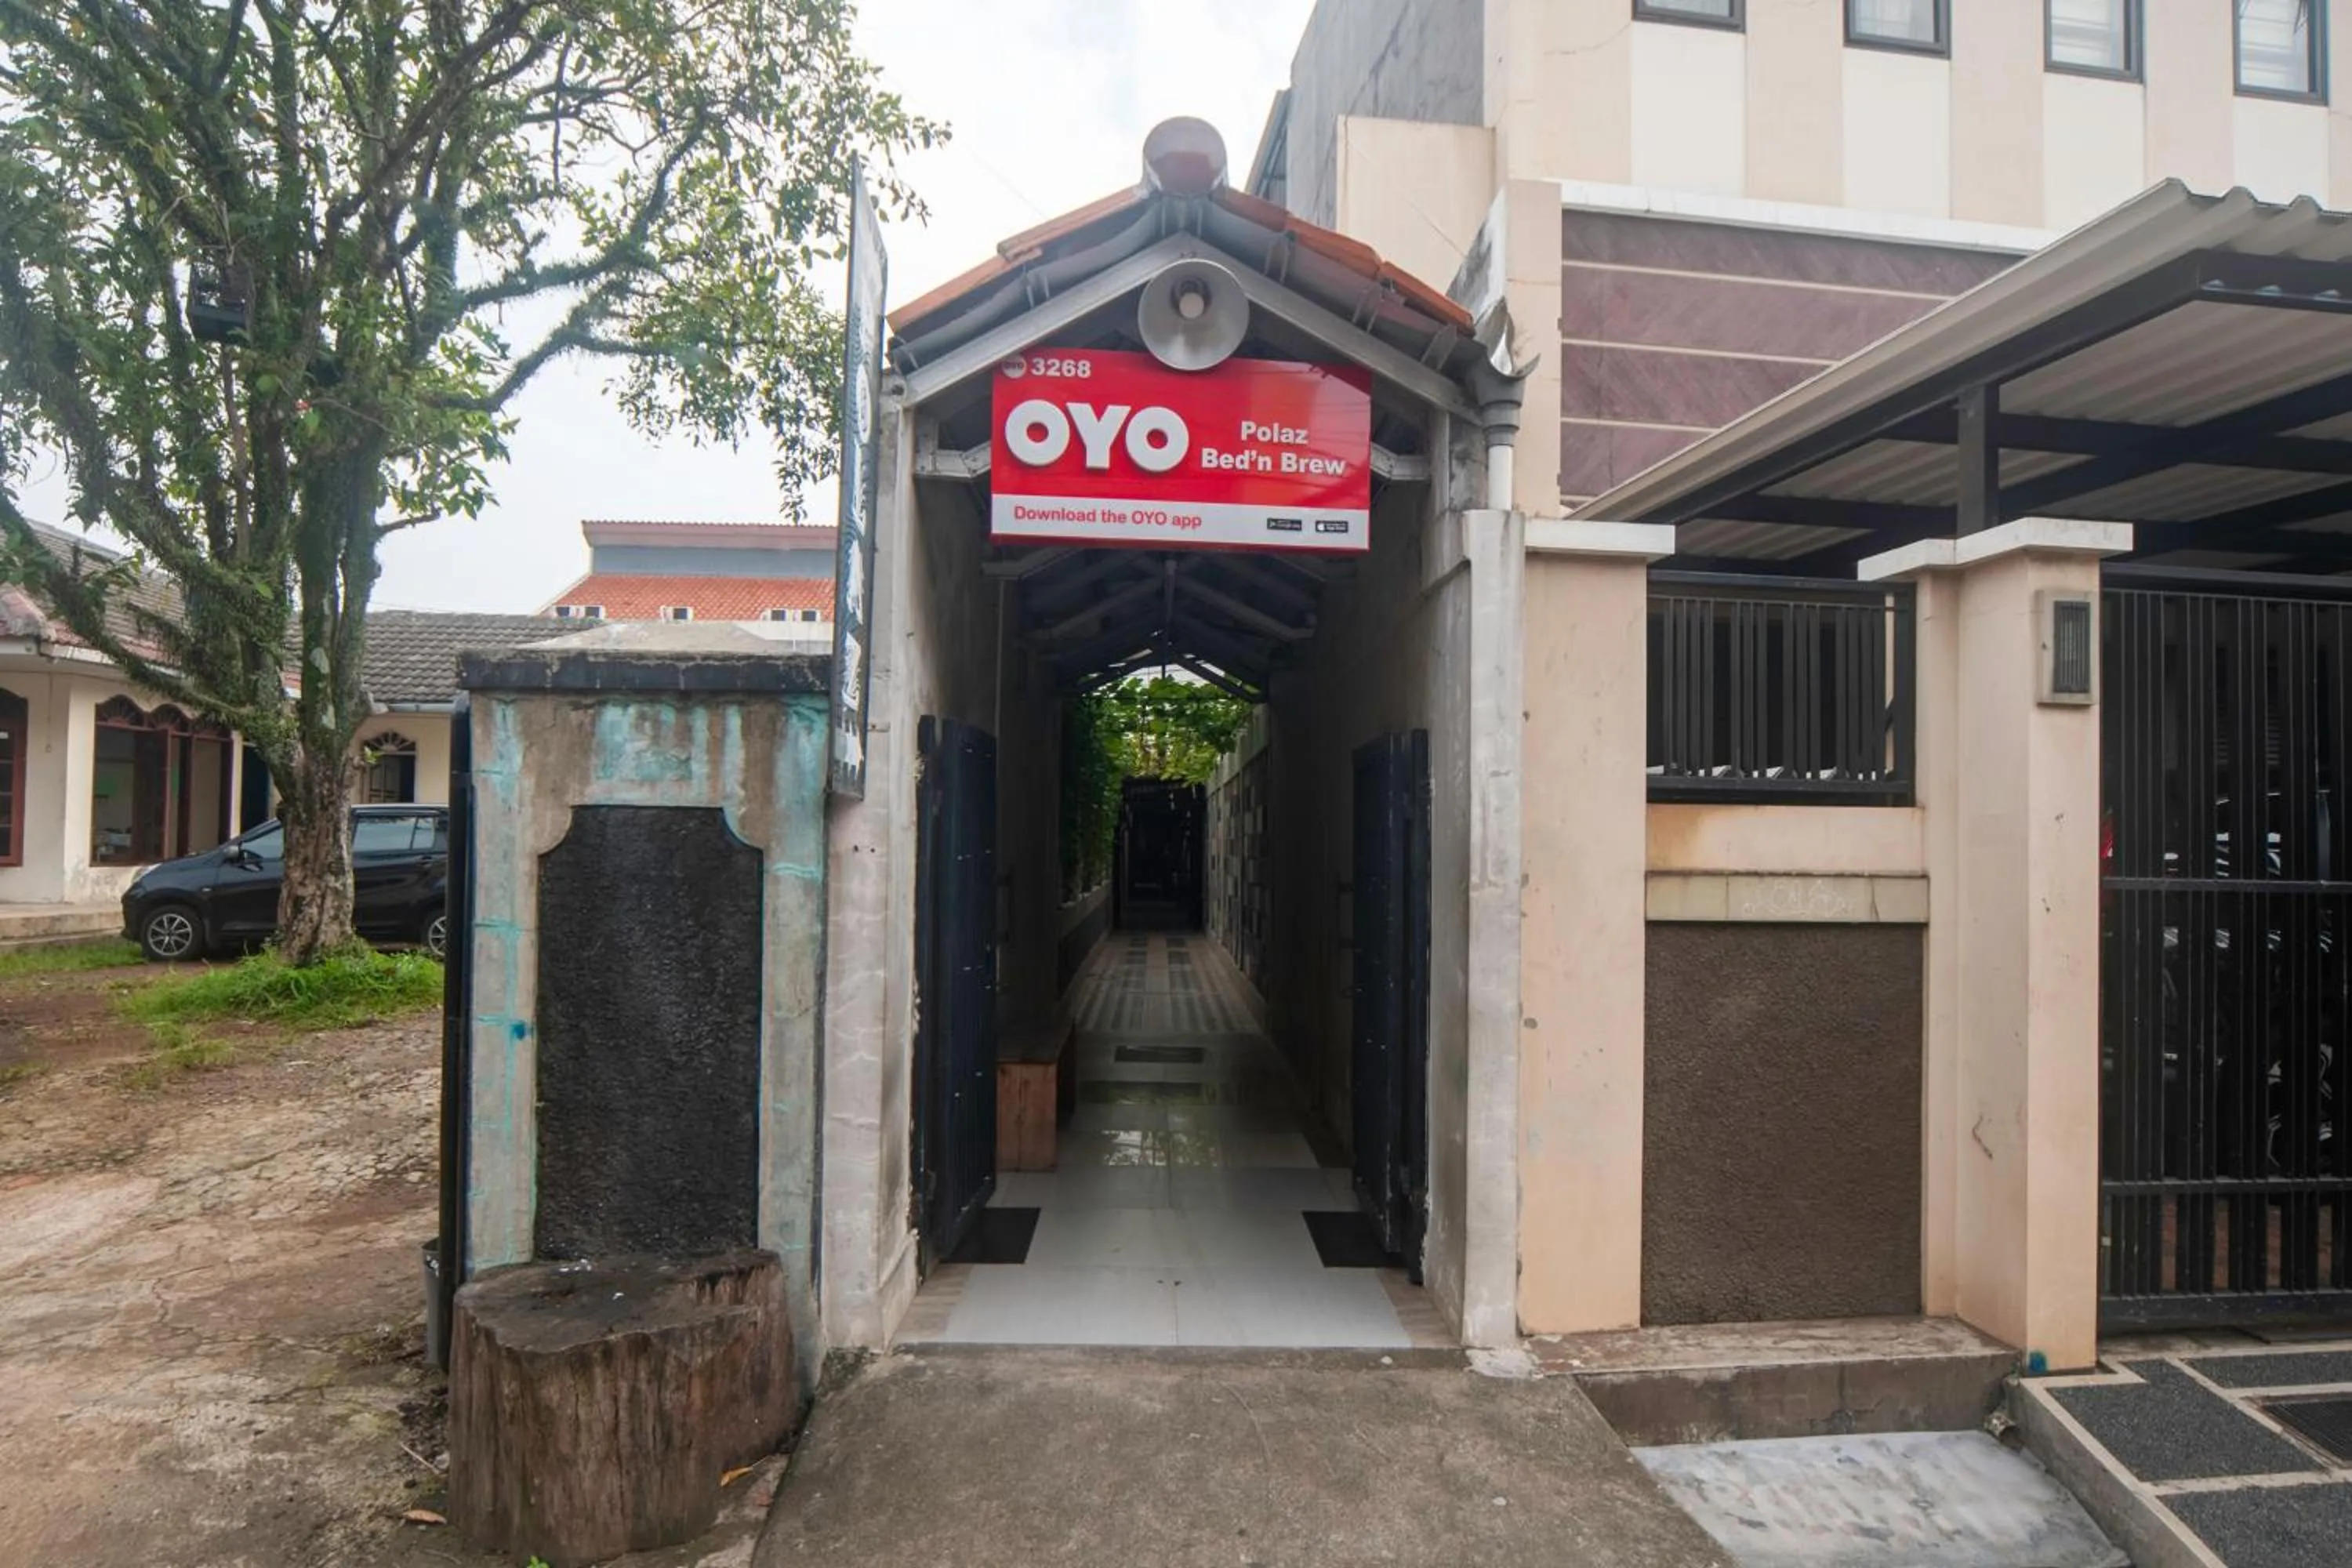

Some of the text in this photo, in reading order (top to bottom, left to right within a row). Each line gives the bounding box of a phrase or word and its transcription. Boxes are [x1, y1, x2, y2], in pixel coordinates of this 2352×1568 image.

[1031, 358, 1091, 378] 3268
[1005, 400, 1189, 472] OYO
[1241, 421, 1308, 444] Polaz
[1281, 453, 1346, 475] Brew
[1014, 506, 1202, 529] Download the OYO app
